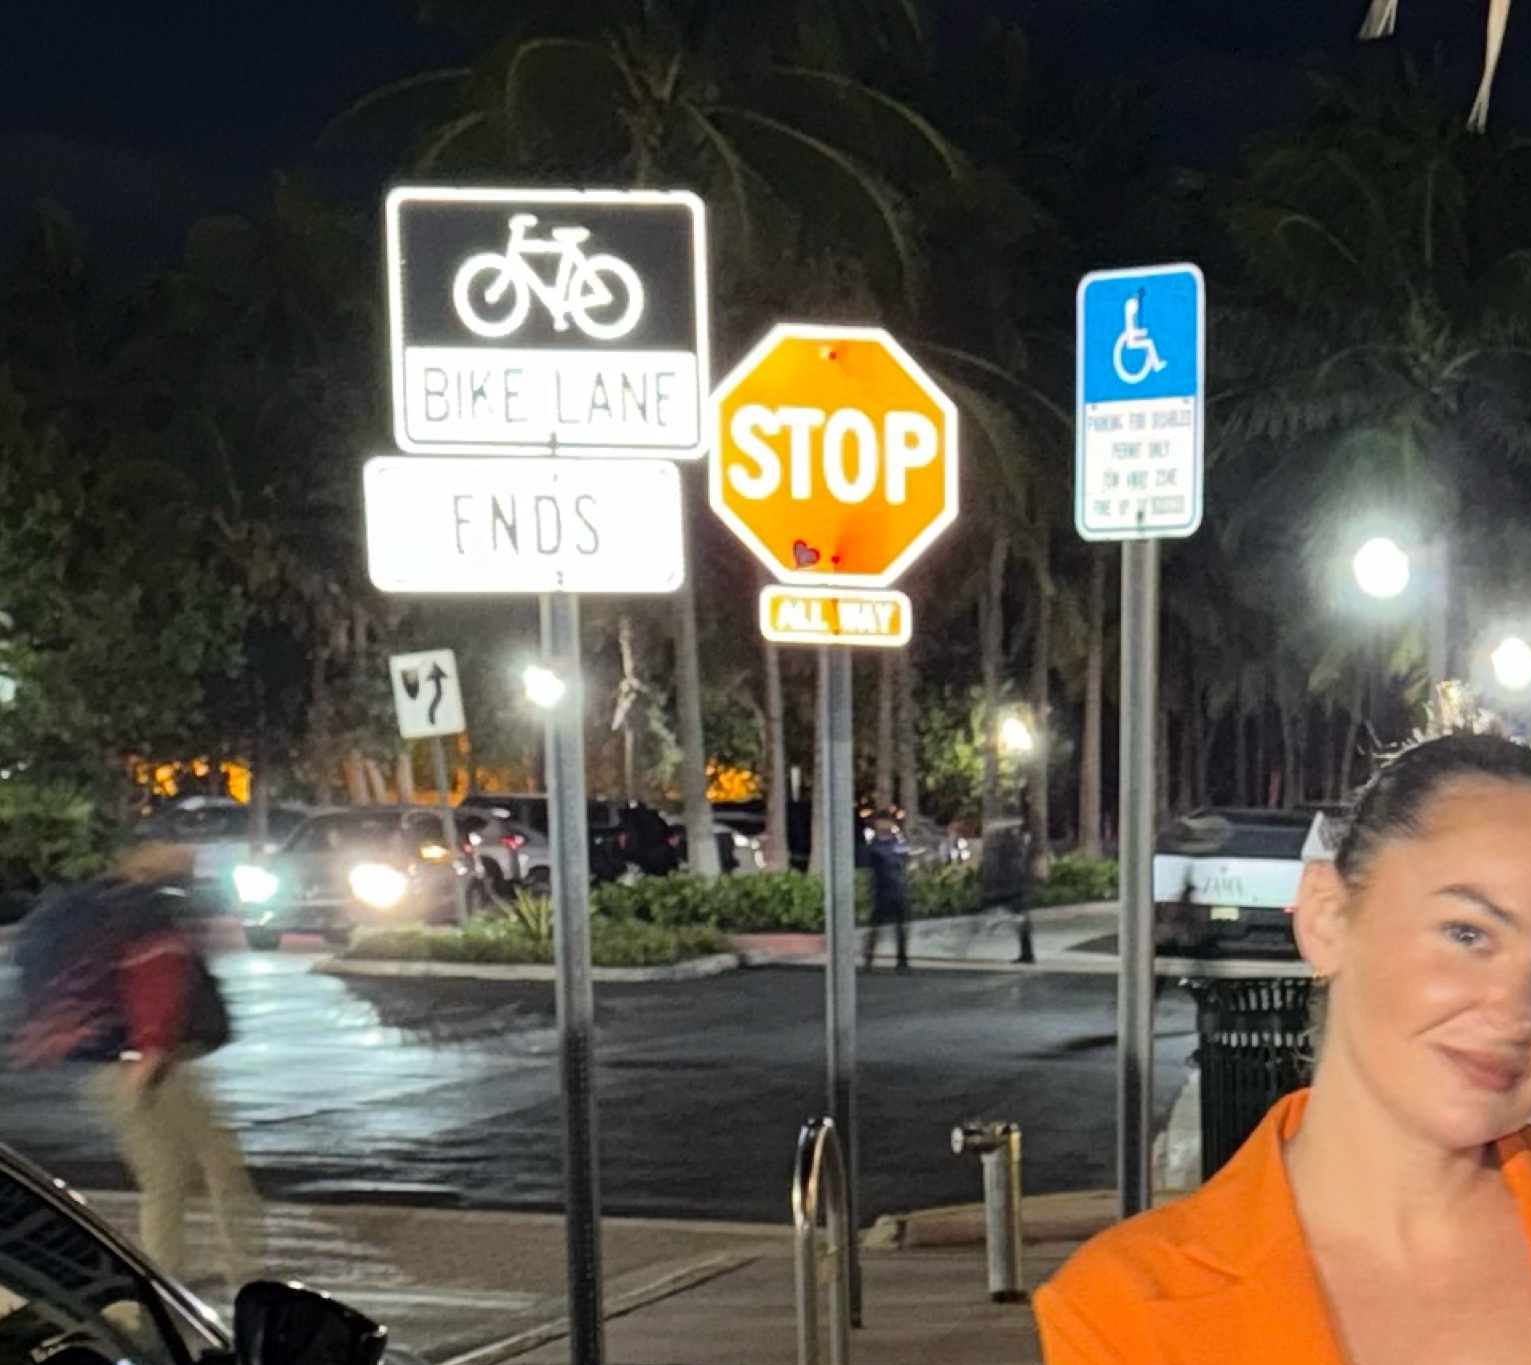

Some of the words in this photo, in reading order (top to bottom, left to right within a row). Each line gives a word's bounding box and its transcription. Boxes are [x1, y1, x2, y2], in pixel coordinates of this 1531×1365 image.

[424, 367, 528, 423] BIKE
[555, 369, 676, 427] LANE
[728, 404, 938, 505] STOP
[452, 493, 600, 556] ENDS
[776, 598, 829, 631] ALL
[840, 601, 895, 634] WAY
